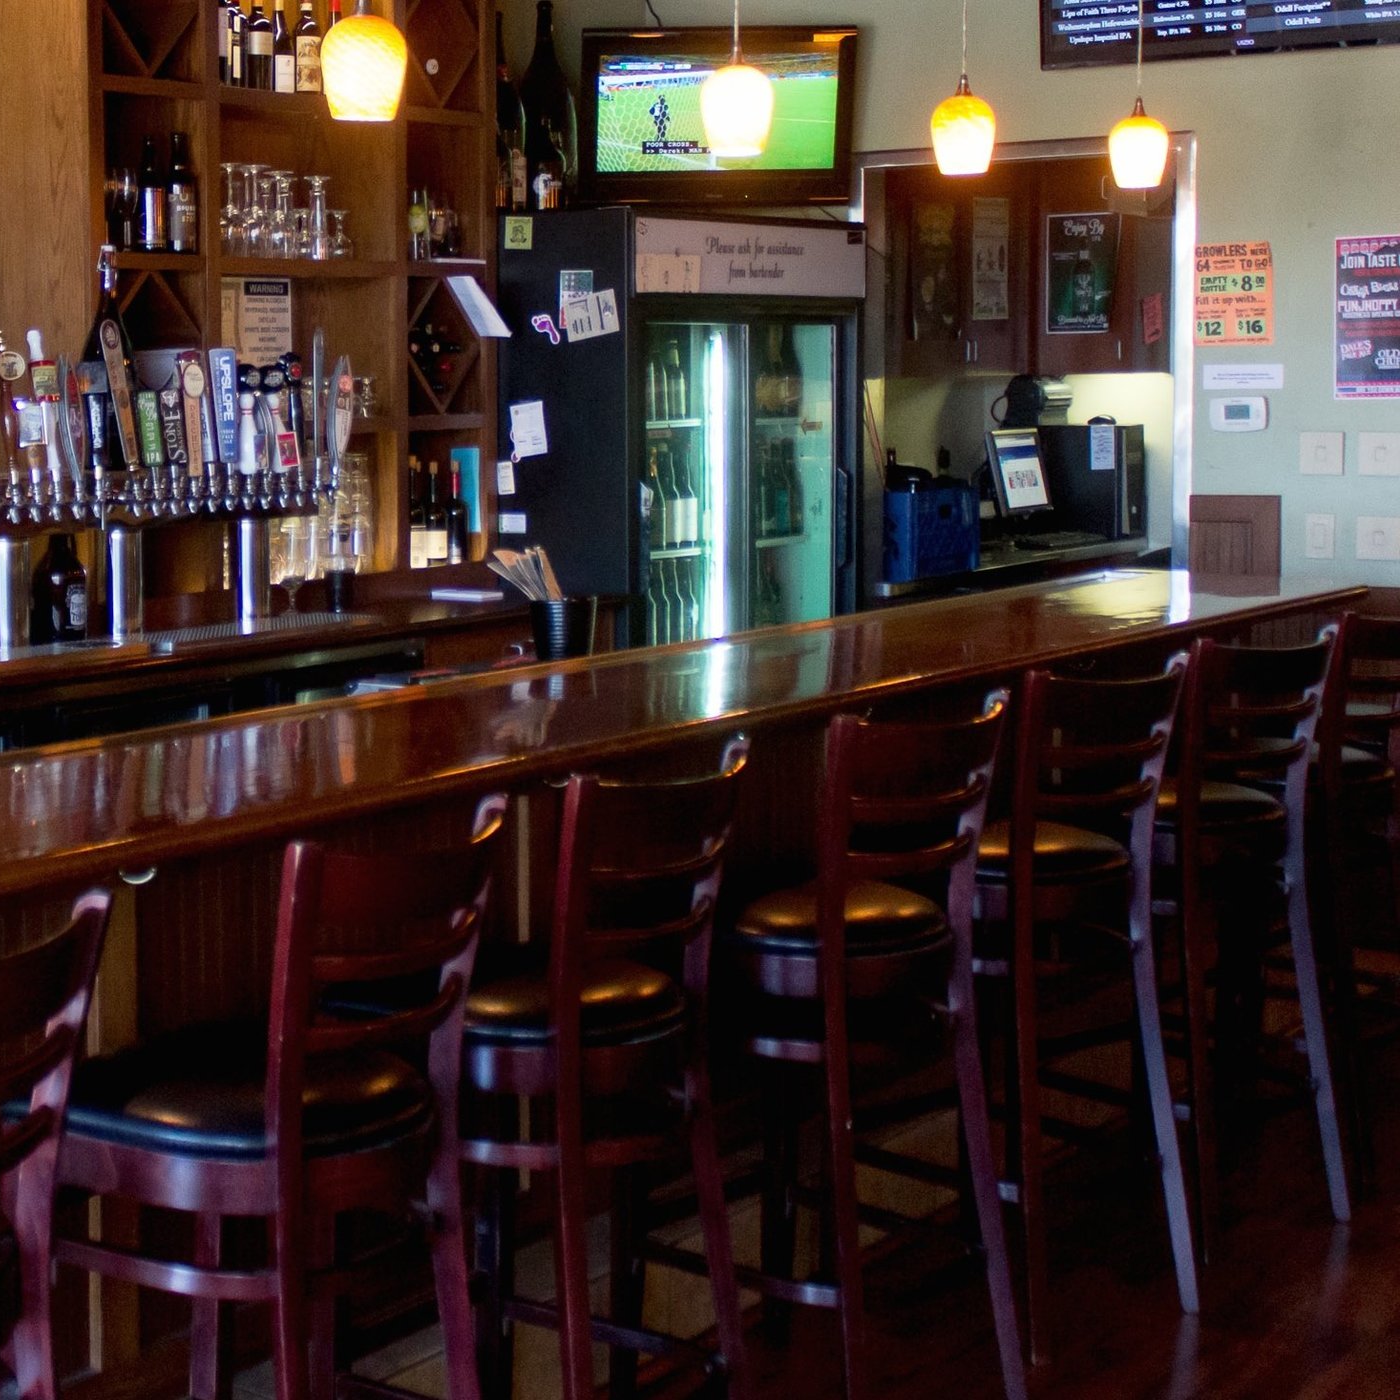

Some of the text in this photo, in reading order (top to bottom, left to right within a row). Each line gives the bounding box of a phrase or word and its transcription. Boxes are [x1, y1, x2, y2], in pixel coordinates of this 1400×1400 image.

[1083, 7, 1099, 15] Faith
[1100, 6, 1117, 14] Three
[1117, 4, 1139, 14] Floyds
[1274, 4, 1293, 13] Odell
[1285, 18, 1304, 26] Odell
[1068, 34, 1093, 44] Upslope
[1119, 32, 1132, 40] IPA
[1063, 220, 1088, 236] Enjoy
[705, 236, 804, 260] Please ask for assistance
[1195, 244, 1247, 258] GROWLERS
[1196, 259, 1211, 273] 64
[1341, 252, 1397, 269] JOIN TASTE
[728, 260, 784, 284] from bartender
[1200, 275, 1227, 286] EMPTY
[248, 283, 284, 294] WARNING
[1195, 296, 1209, 305] Fill
[1196, 319, 1263, 336] $12 $16
[220, 356, 234, 421] UPSLOPE
[162, 409, 187, 464] STONE
[146, 452, 161, 463] IPA
